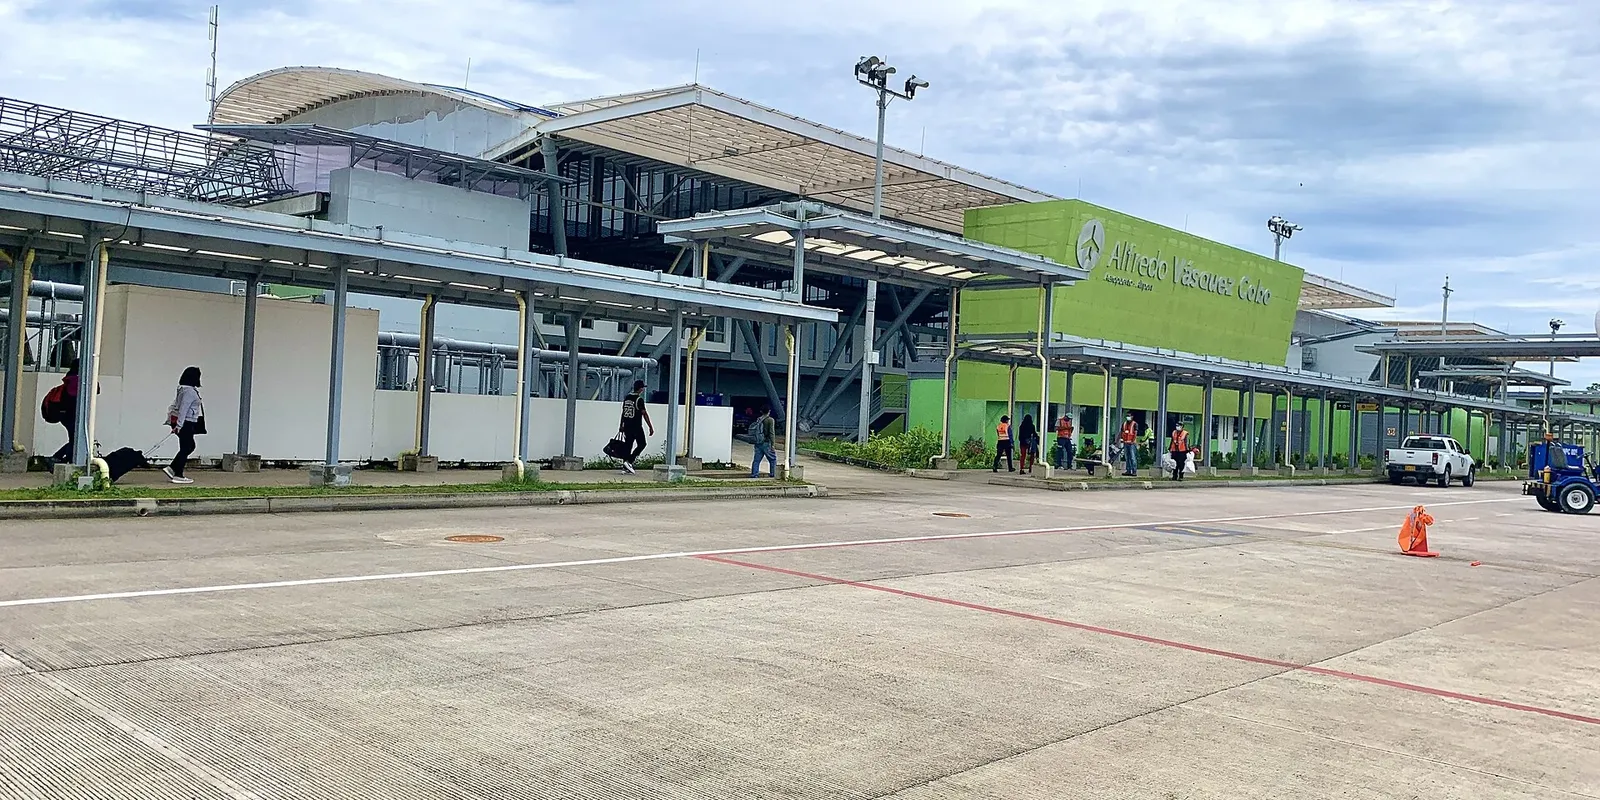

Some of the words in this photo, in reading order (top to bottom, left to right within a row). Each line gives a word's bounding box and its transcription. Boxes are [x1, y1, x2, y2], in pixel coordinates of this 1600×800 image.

[1106, 240, 1168, 281] Alfredo
[1173, 255, 1235, 297] Vásquez
[1237, 275, 1272, 306] Cobo
